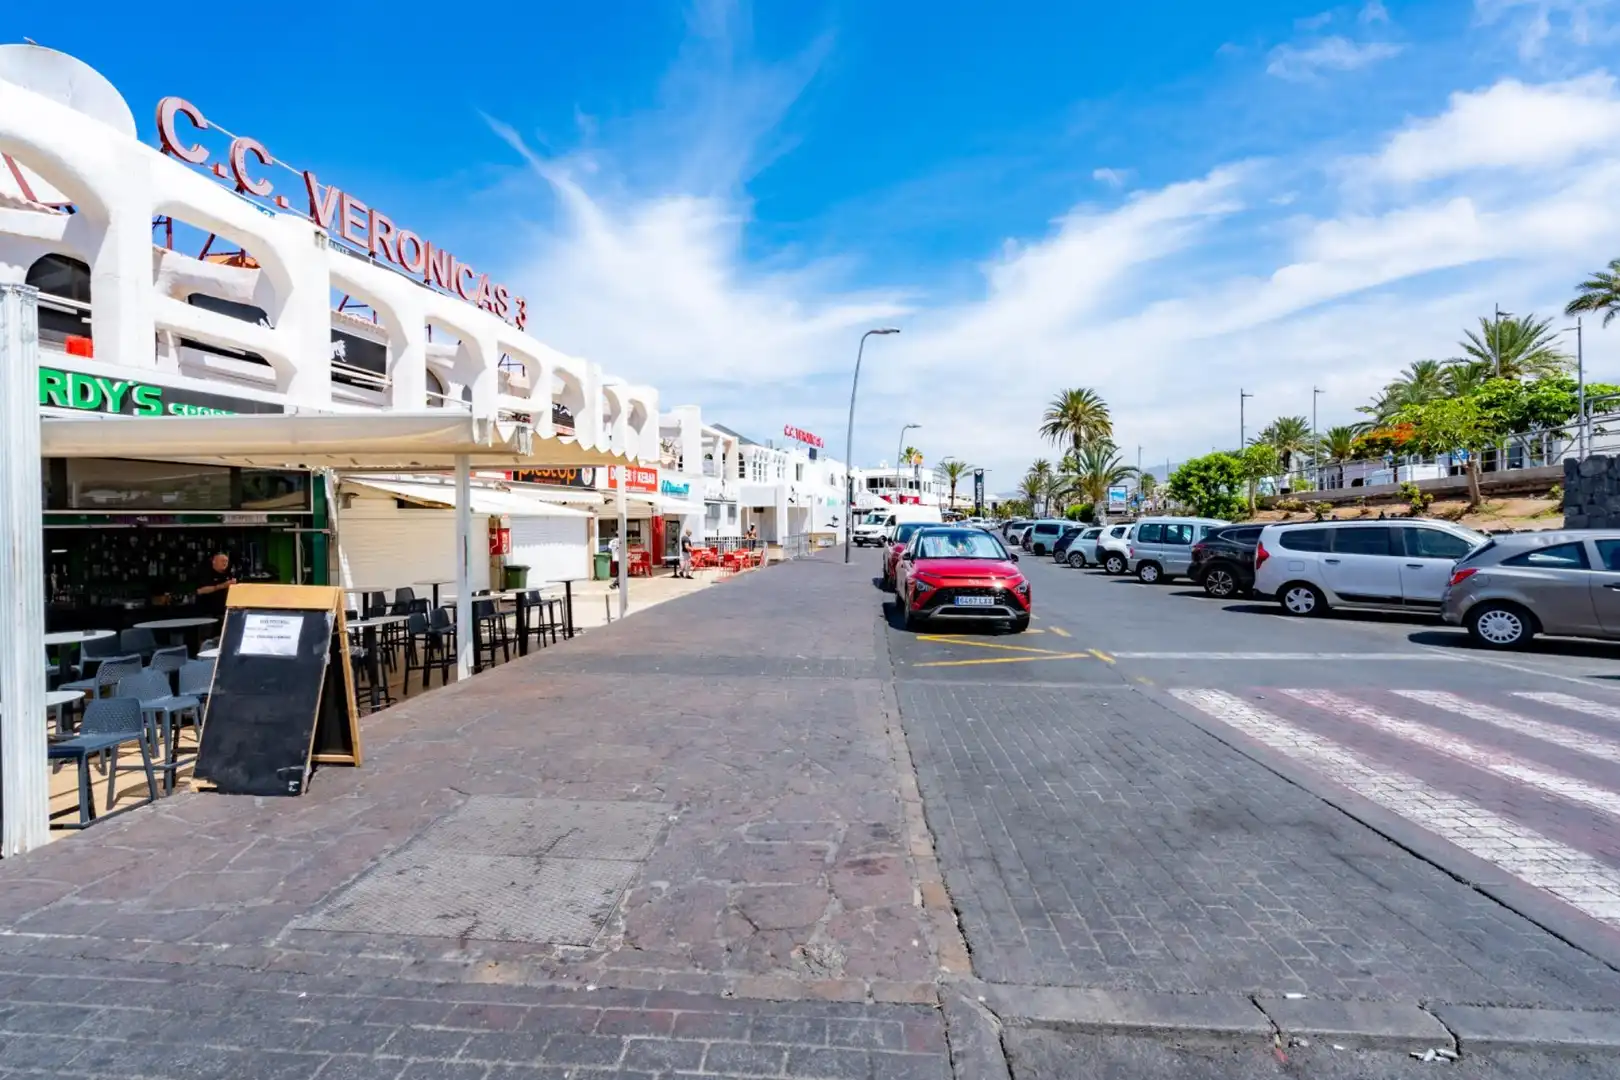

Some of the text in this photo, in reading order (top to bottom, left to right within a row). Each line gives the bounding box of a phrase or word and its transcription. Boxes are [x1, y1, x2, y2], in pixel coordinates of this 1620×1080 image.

[156, 96, 528, 329] C.C. VERONICAS 3
